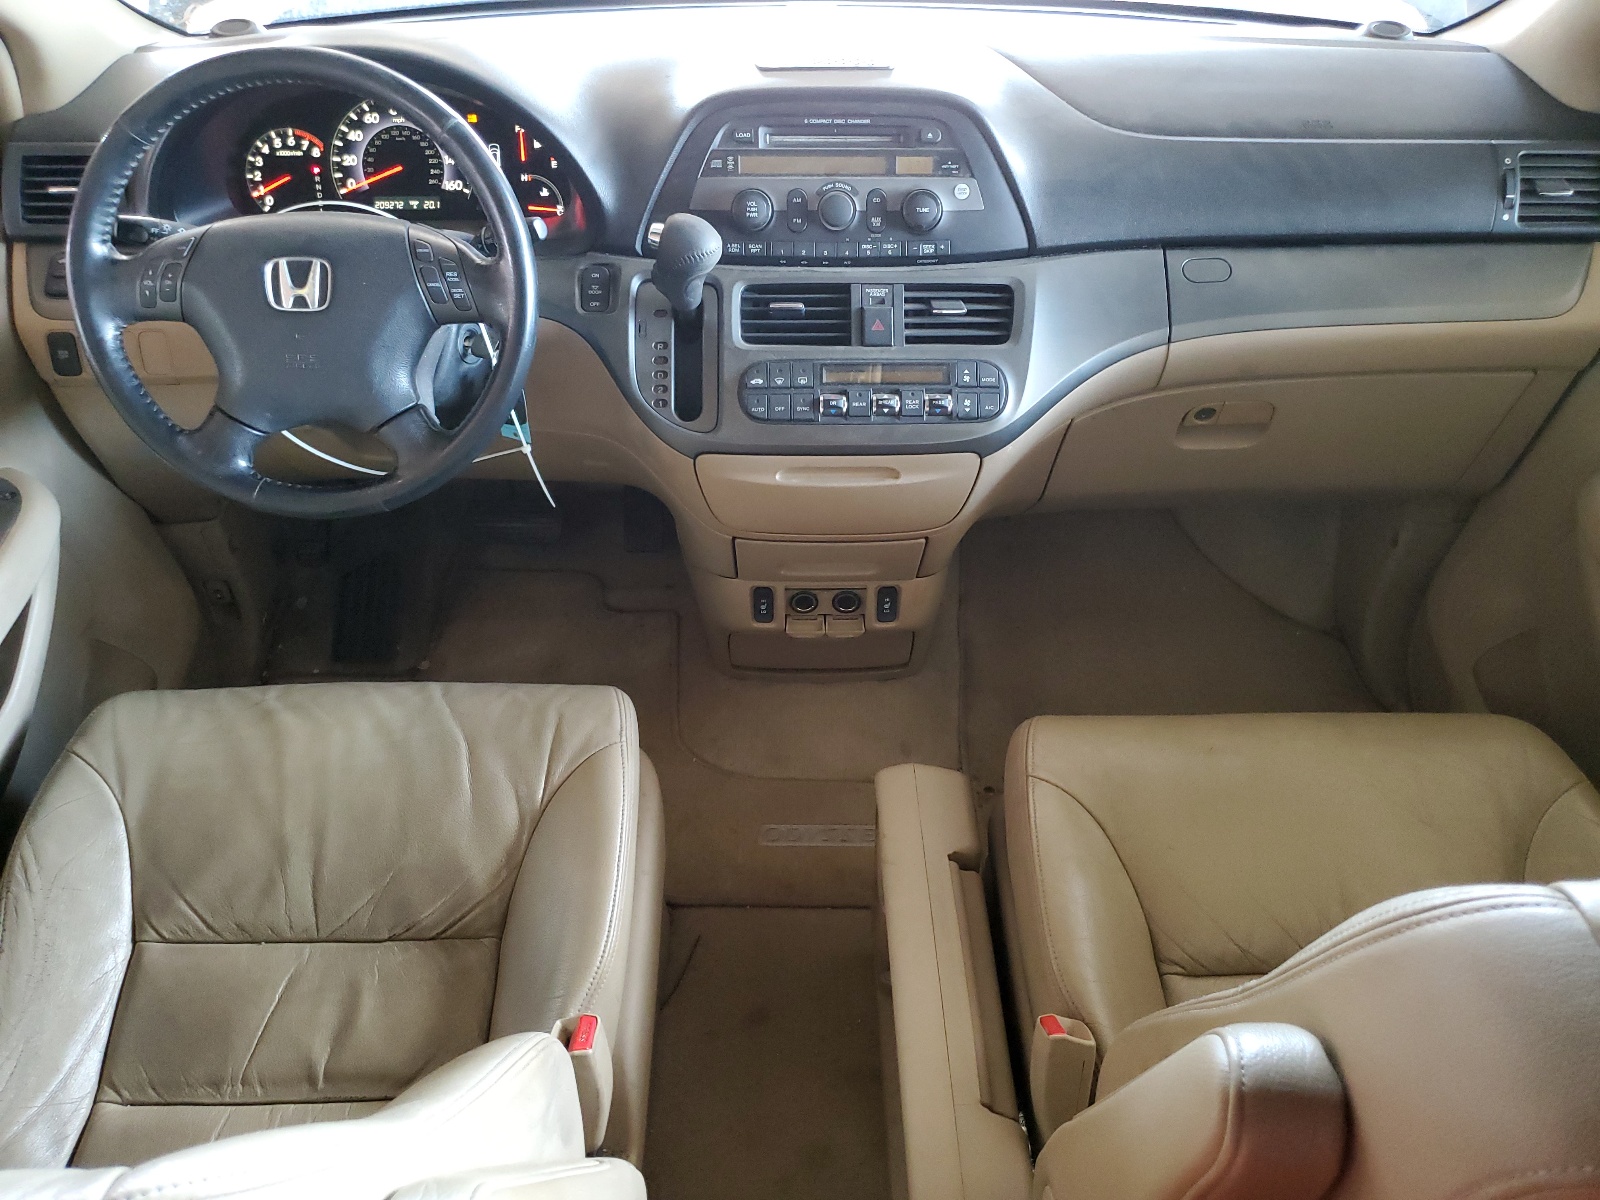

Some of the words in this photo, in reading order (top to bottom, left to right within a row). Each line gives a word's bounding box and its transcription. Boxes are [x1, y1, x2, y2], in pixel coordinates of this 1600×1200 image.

[362, 112, 380, 124] 60
[346, 130, 363, 142] 40
[273, 138, 282, 148] 5
[287, 136, 296, 147] 6
[301, 140, 310, 151] 7
[261, 144, 270, 155] 4
[310, 146, 321, 158] 8
[255, 156, 264, 167] 3
[341, 157, 358, 166] 20
[551, 160, 558, 169] E
[253, 171, 262, 181] 2
[521, 173, 528, 182] H
[444, 180, 463, 190] 160
[835, 182, 852, 192] SOUND
[264, 195, 275, 206] 0
[374, 200, 404, 209] 209272
